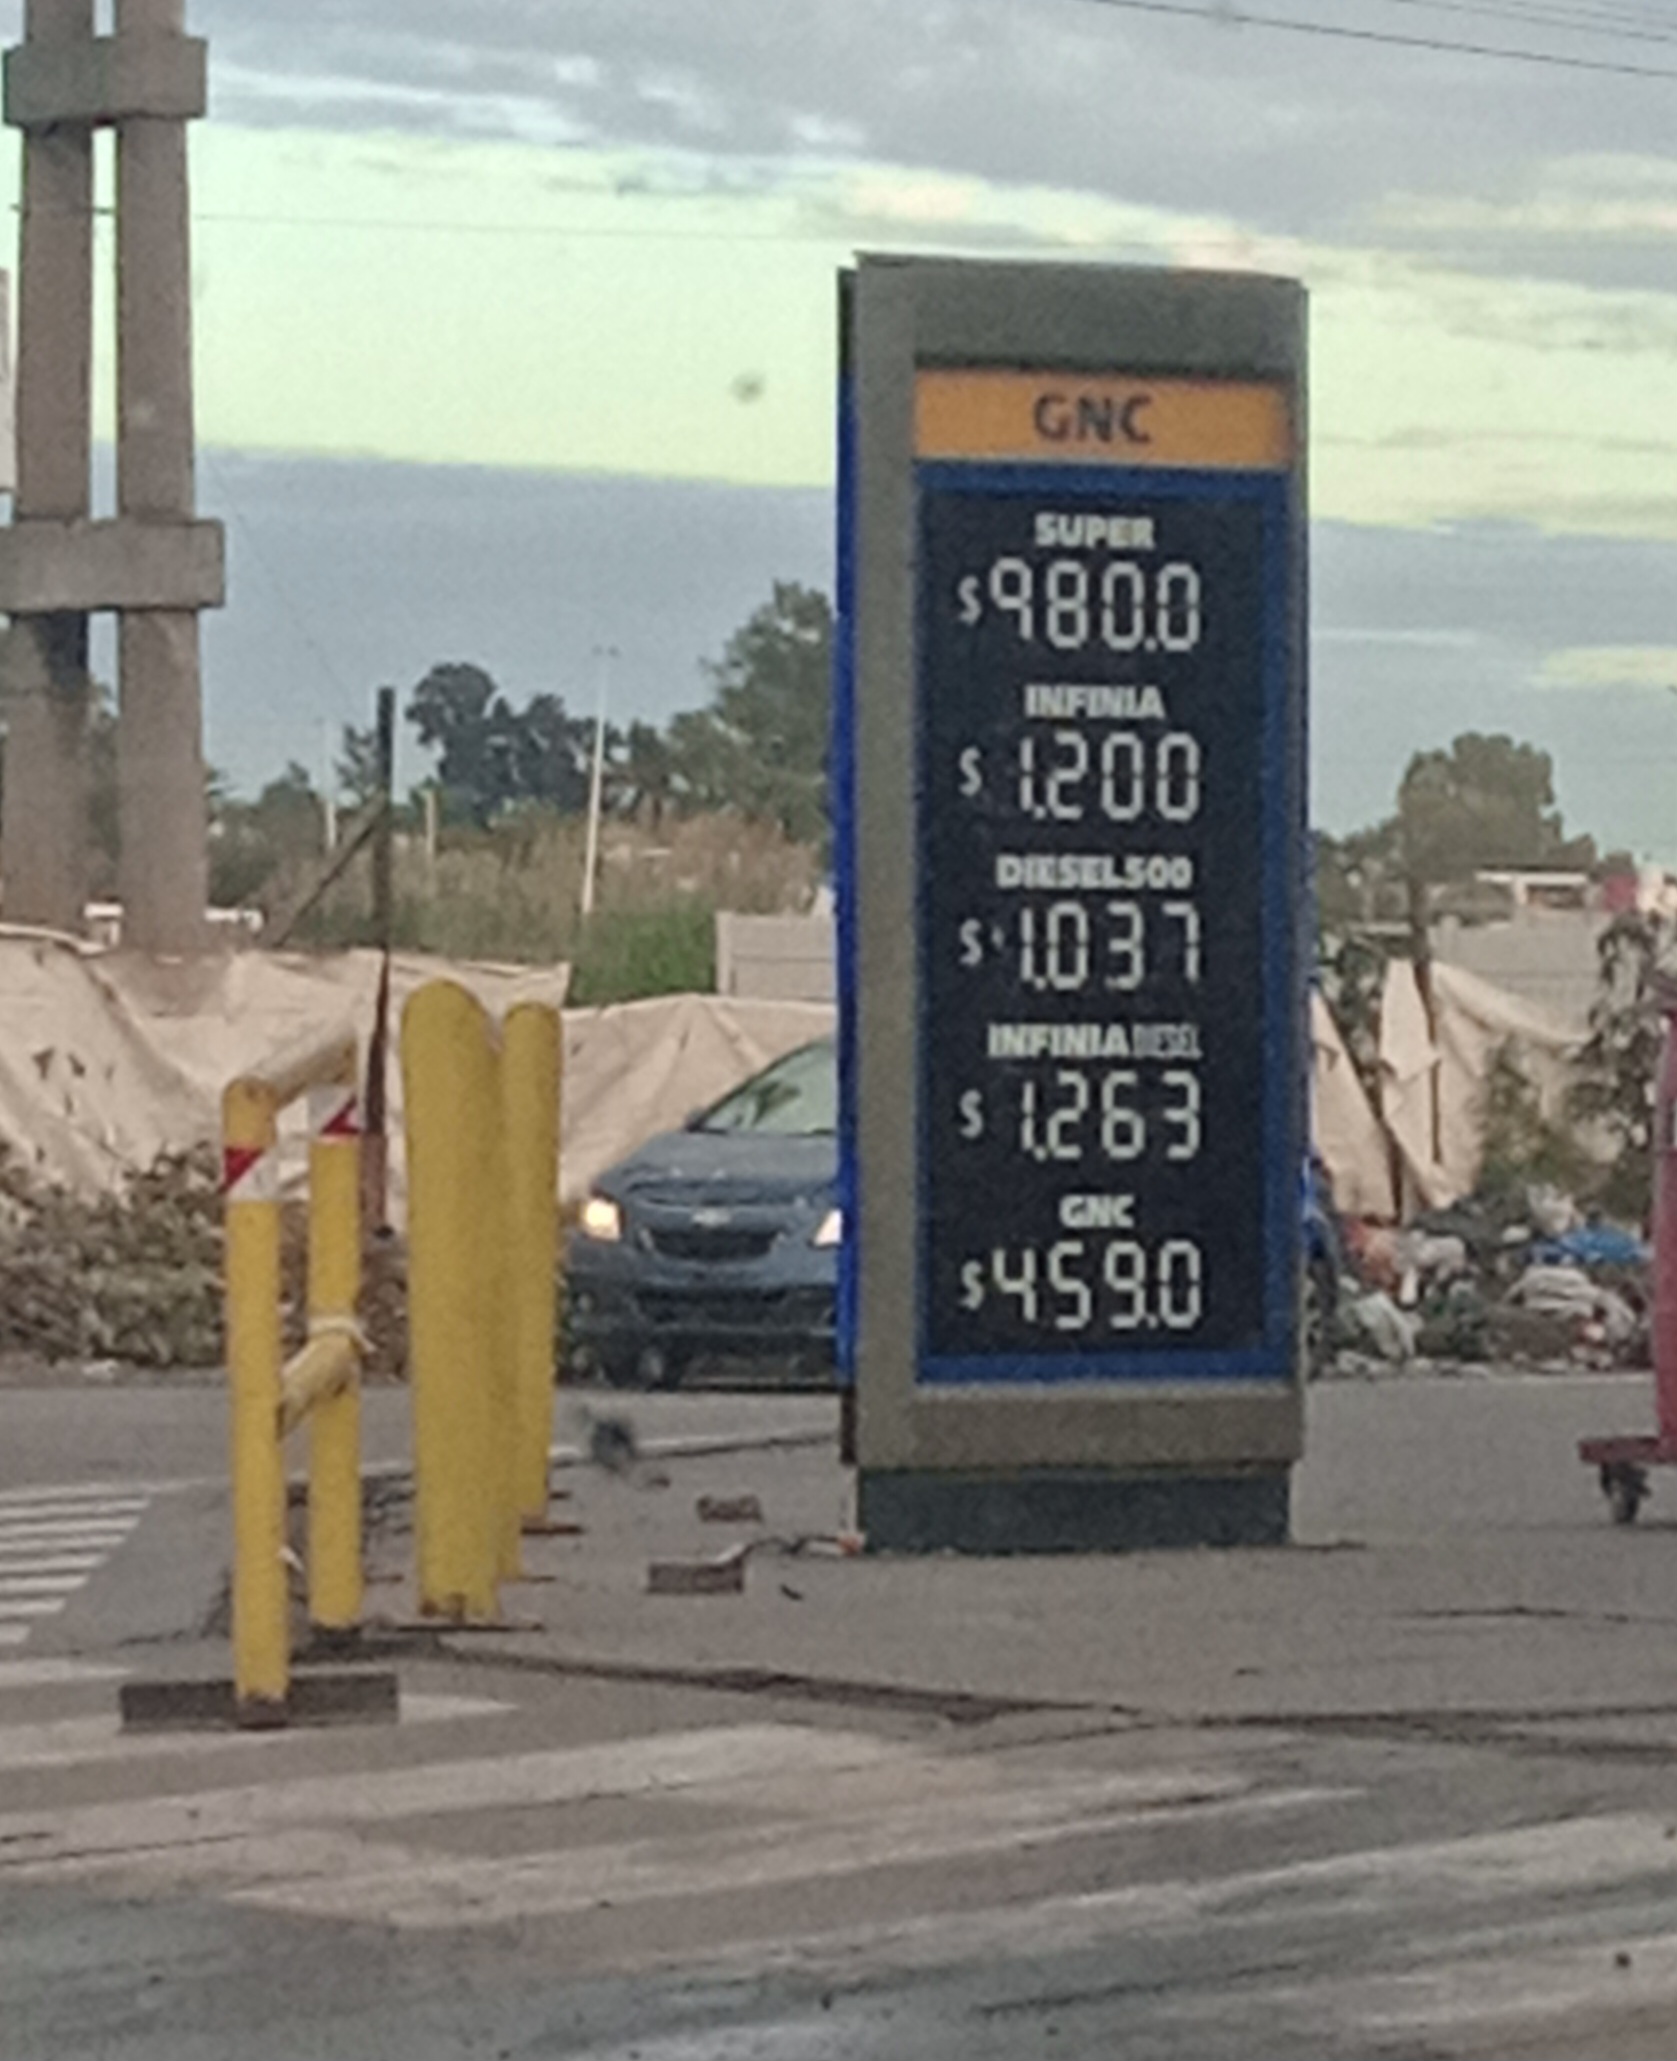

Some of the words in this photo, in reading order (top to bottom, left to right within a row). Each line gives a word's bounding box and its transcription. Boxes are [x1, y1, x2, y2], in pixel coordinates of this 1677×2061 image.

[1034, 394, 1153, 444] GNC
[1034, 513, 1156, 550] SUPER
[1024, 684, 1165, 719] INFINIA
[1019, 732, 1200, 822] 1.200
[987, 1023, 1130, 1057] INFINIA
[1131, 1024, 1204, 1058] DIESEL
[1021, 1071, 1200, 1160] 1.263
[1059, 1195, 1136, 1229] GNC
